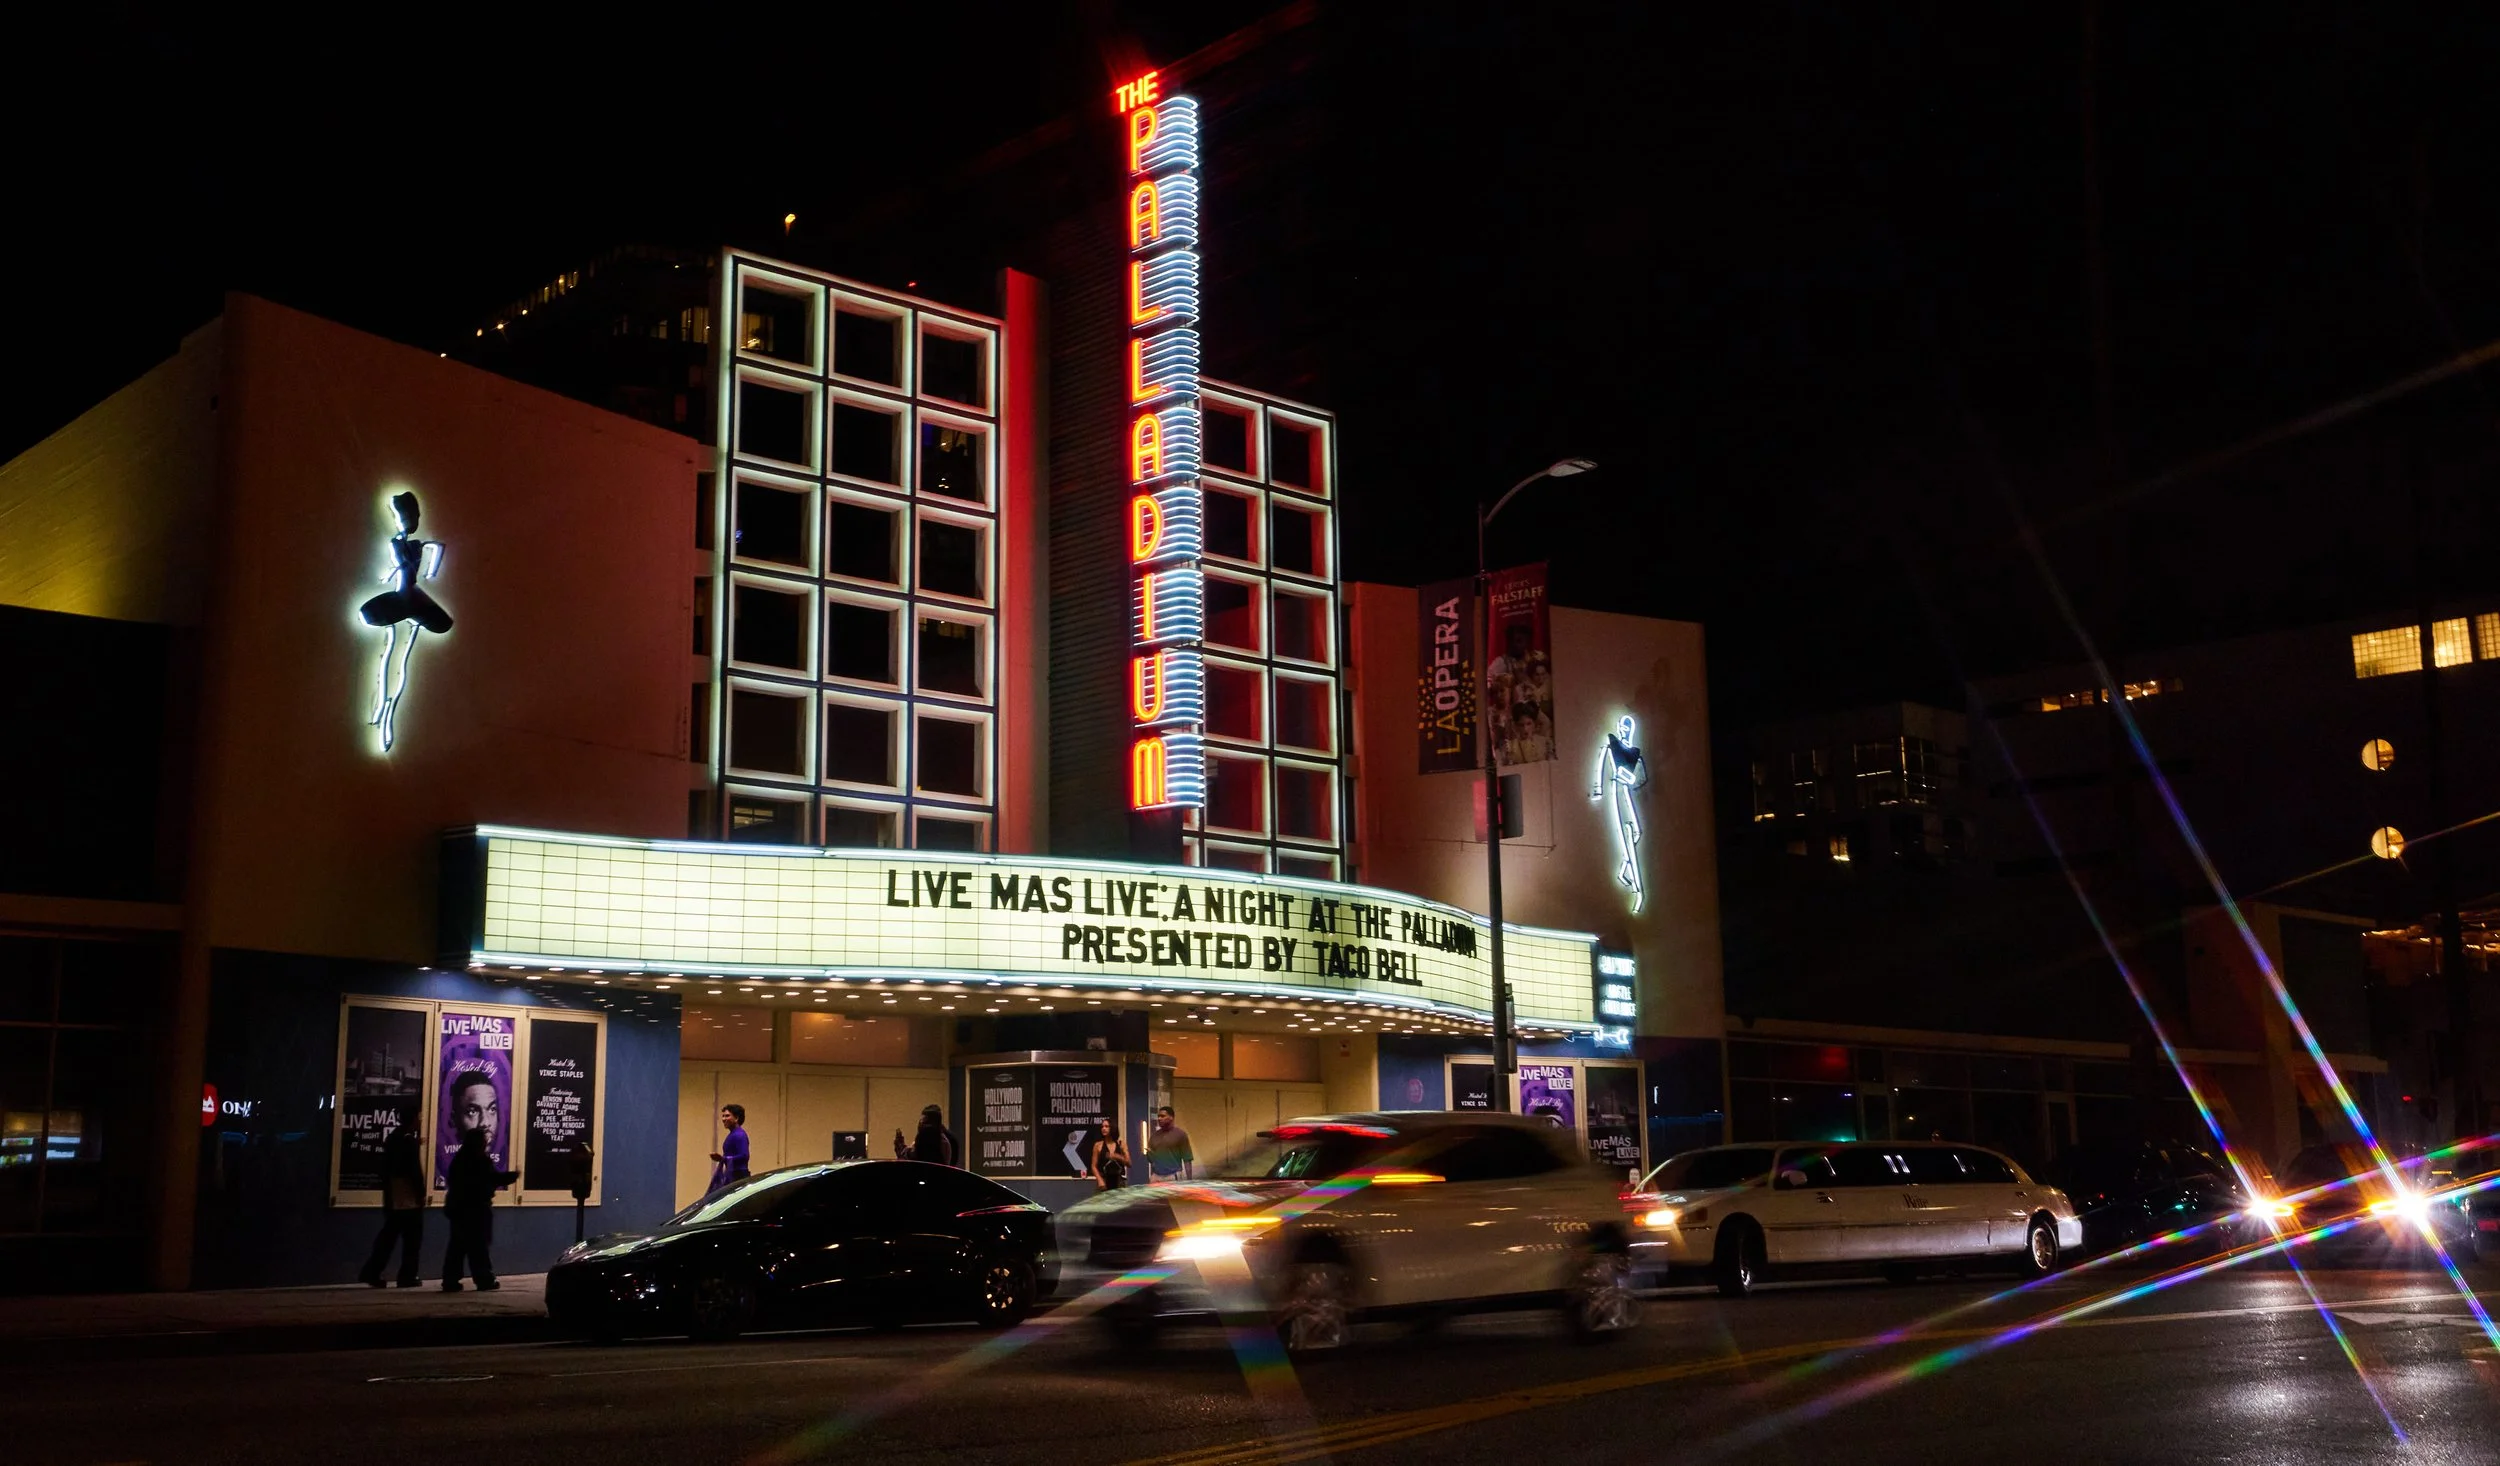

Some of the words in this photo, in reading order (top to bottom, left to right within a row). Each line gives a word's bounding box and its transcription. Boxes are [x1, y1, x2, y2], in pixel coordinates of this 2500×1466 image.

[1116, 71, 1158, 113] THE
[1130, 105, 1168, 807] PALLADIUM
[1491, 585, 1545, 606] FALSTAFF
[887, 869, 972, 909] LIVE
[990, 872, 1073, 913] MAS
[1171, 884, 1196, 922] A
[1204, 886, 1295, 930] NIGHT
[1308, 897, 1340, 934] AT
[1351, 903, 1393, 941] THE
[1062, 923, 1252, 970] PRESENTED
[1263, 936, 1298, 972] BY
[1312, 940, 1371, 979] TACO
[1377, 948, 1423, 987] BELL
[441, 1019, 470, 1035] LIVE
[470, 1016, 502, 1033] MAS
[483, 1035, 509, 1047] LIVE
[451, 1059, 484, 1072] Hosted
[482, 1060, 498, 1079] By
[539, 1069, 558, 1077] VINCE
[559, 1070, 584, 1078] STAPLES
[1520, 1069, 1540, 1080] LIVE
[1540, 1066, 1565, 1078] MAS
[1049, 1082, 1102, 1098] HOLLYWOOD
[1551, 1079, 1571, 1089] LIVE
[984, 1087, 1023, 1105] HOLLYWOOD
[536, 1100, 560, 1109] DAVANTE
[1051, 1098, 1102, 1114] PALLADIUM
[341, 1113, 373, 1130] LIVE
[985, 1105, 1022, 1123] PALLADIUM
[1041, 1116, 1065, 1125] ENTRANCE
[1072, 1117, 1090, 1125] SUNSET
[361, 1132, 380, 1140] NIGHT
[360, 1144, 372, 1152] THE
[1588, 1139, 1609, 1150] LIVE
